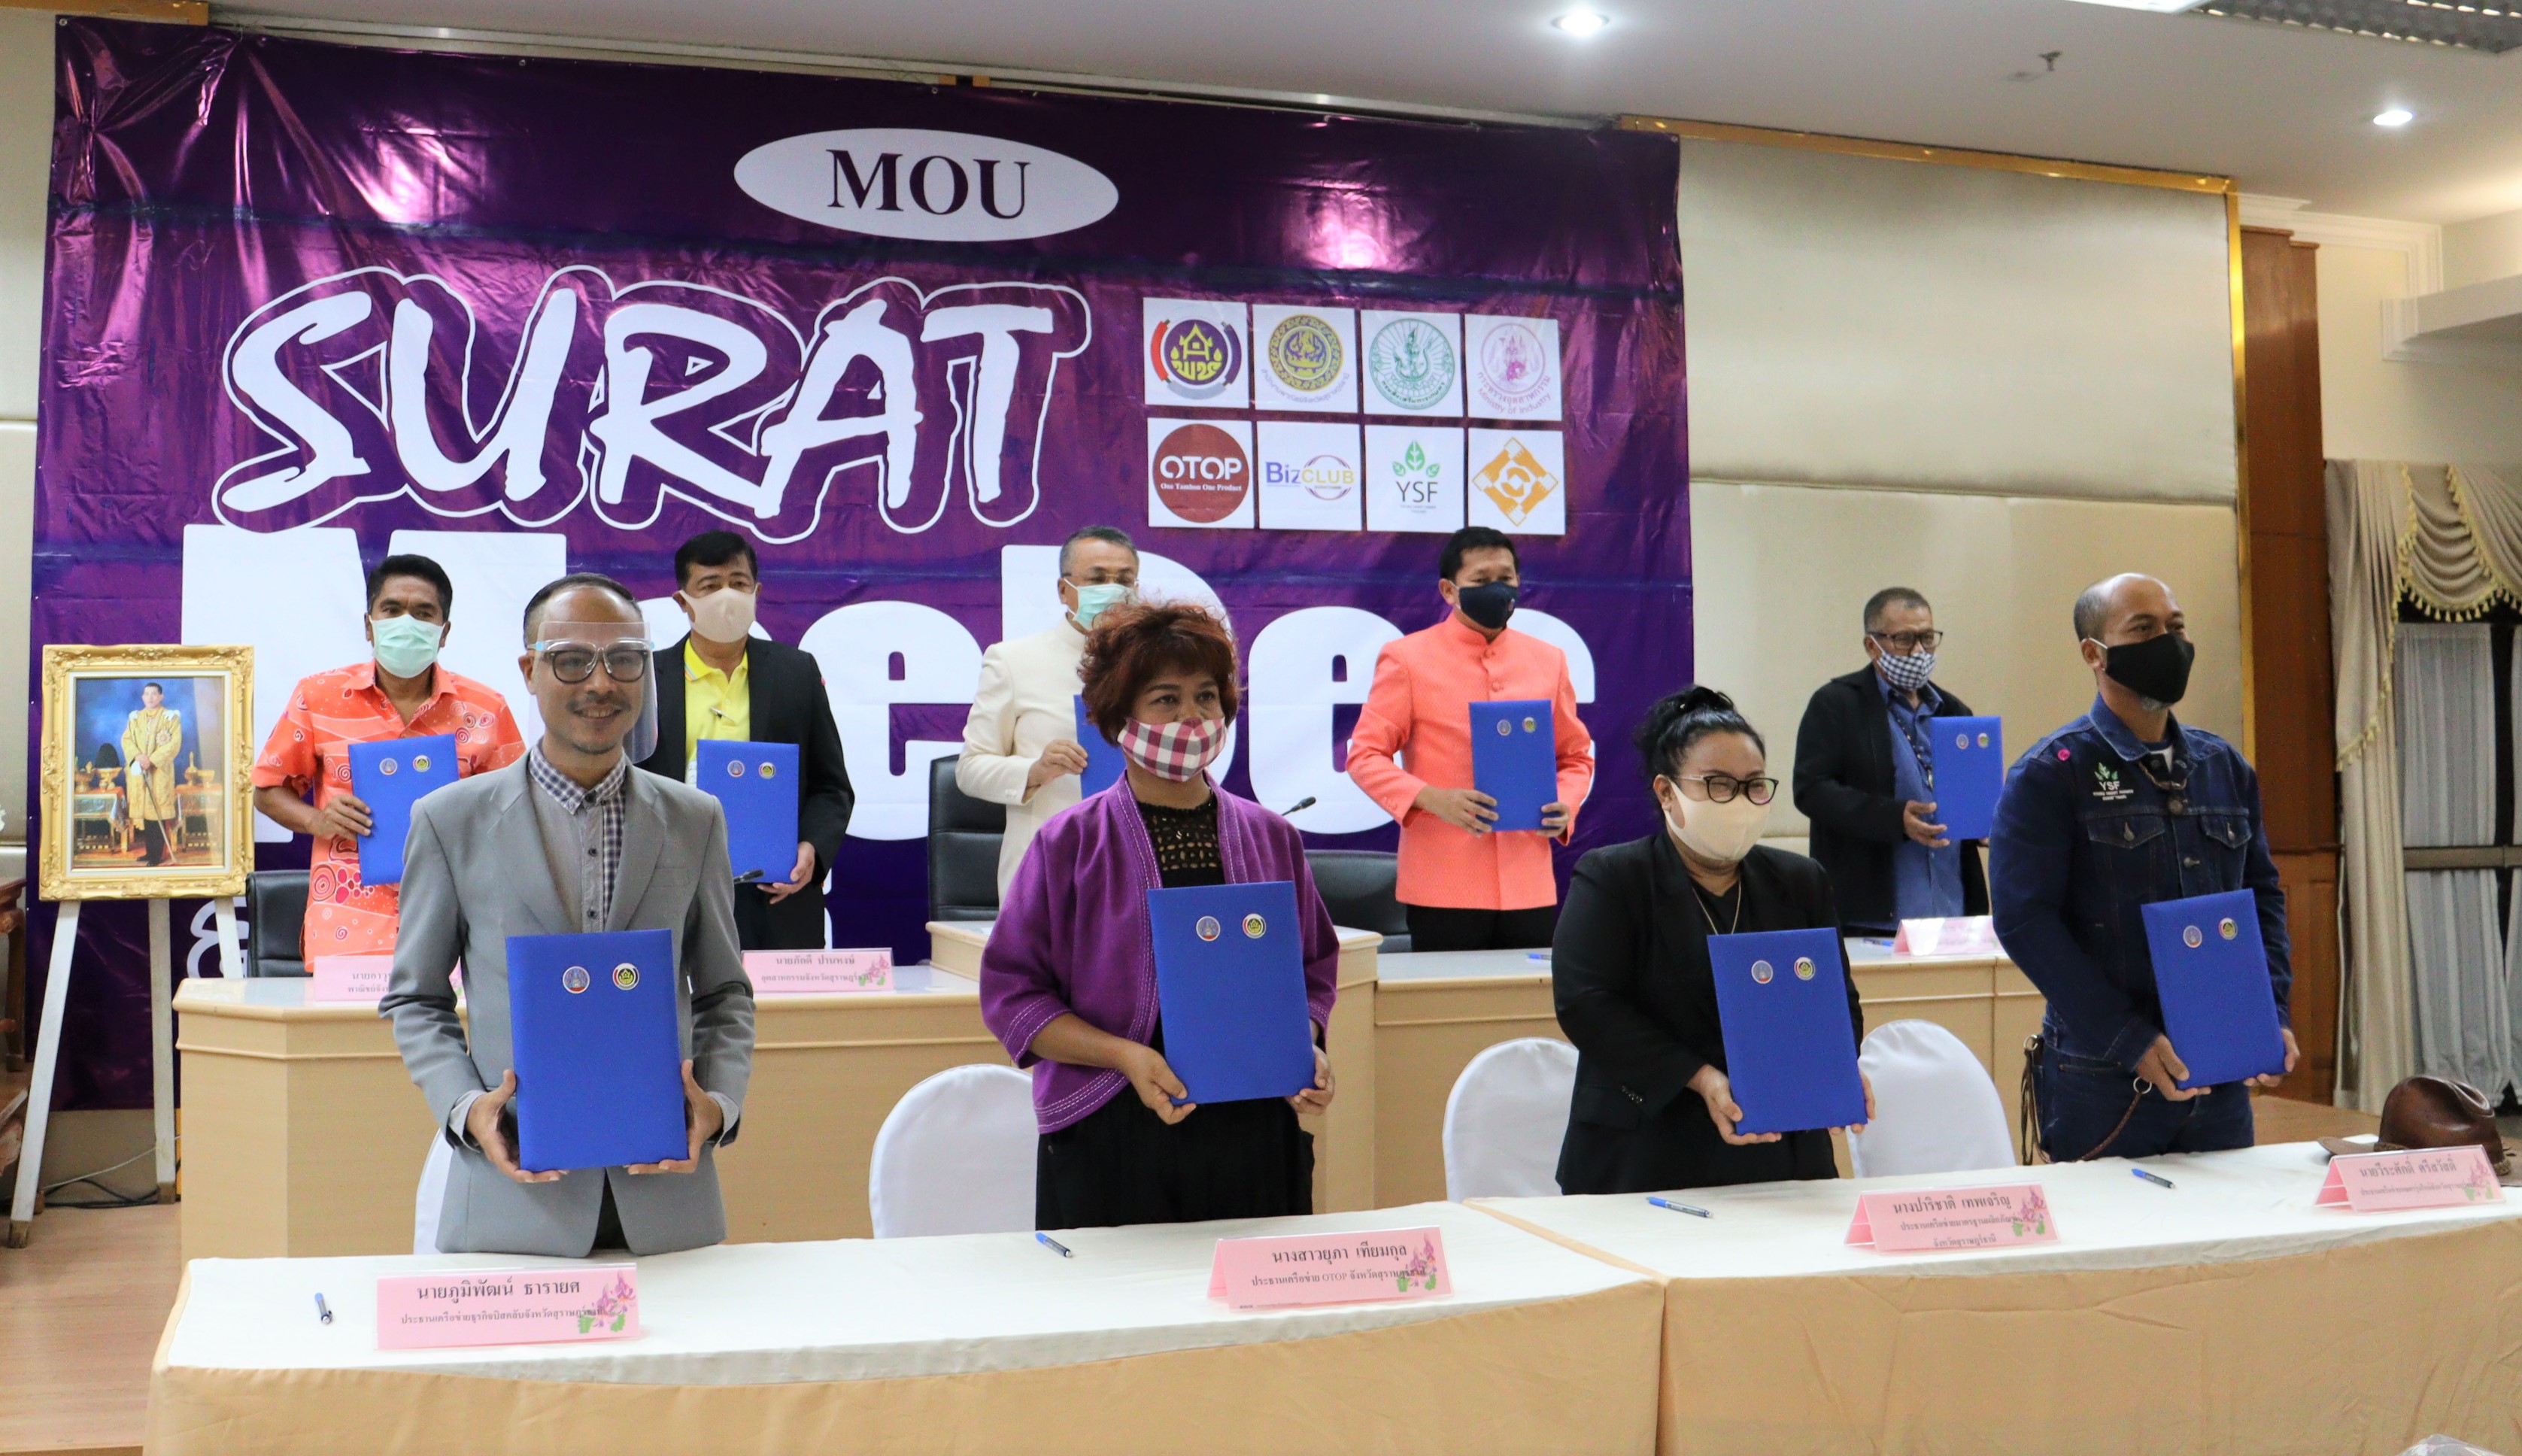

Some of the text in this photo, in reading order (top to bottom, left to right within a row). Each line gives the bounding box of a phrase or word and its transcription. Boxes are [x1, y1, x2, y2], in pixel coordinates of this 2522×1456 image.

[827, 149, 1030, 220] MOU
[220, 284, 1061, 523] SURAT
[1507, 406, 1516, 414] of
[1160, 455, 1242, 480] OTOP
[1396, 481, 1438, 502] YSF
[2099, 781, 2120, 790] YSF
[1893, 1191, 2011, 1214] นางปาริชาติ เทพเจริญ
[1271, 1240, 1407, 1265] นางสาวยุภา เทียมกุล
[417, 1276, 581, 1304] นายภูมิพัฒน์ ธารายศ
[1252, 1271, 1320, 1287] ประธานเครือข่าย
[1322, 1272, 1348, 1282] OTOP
